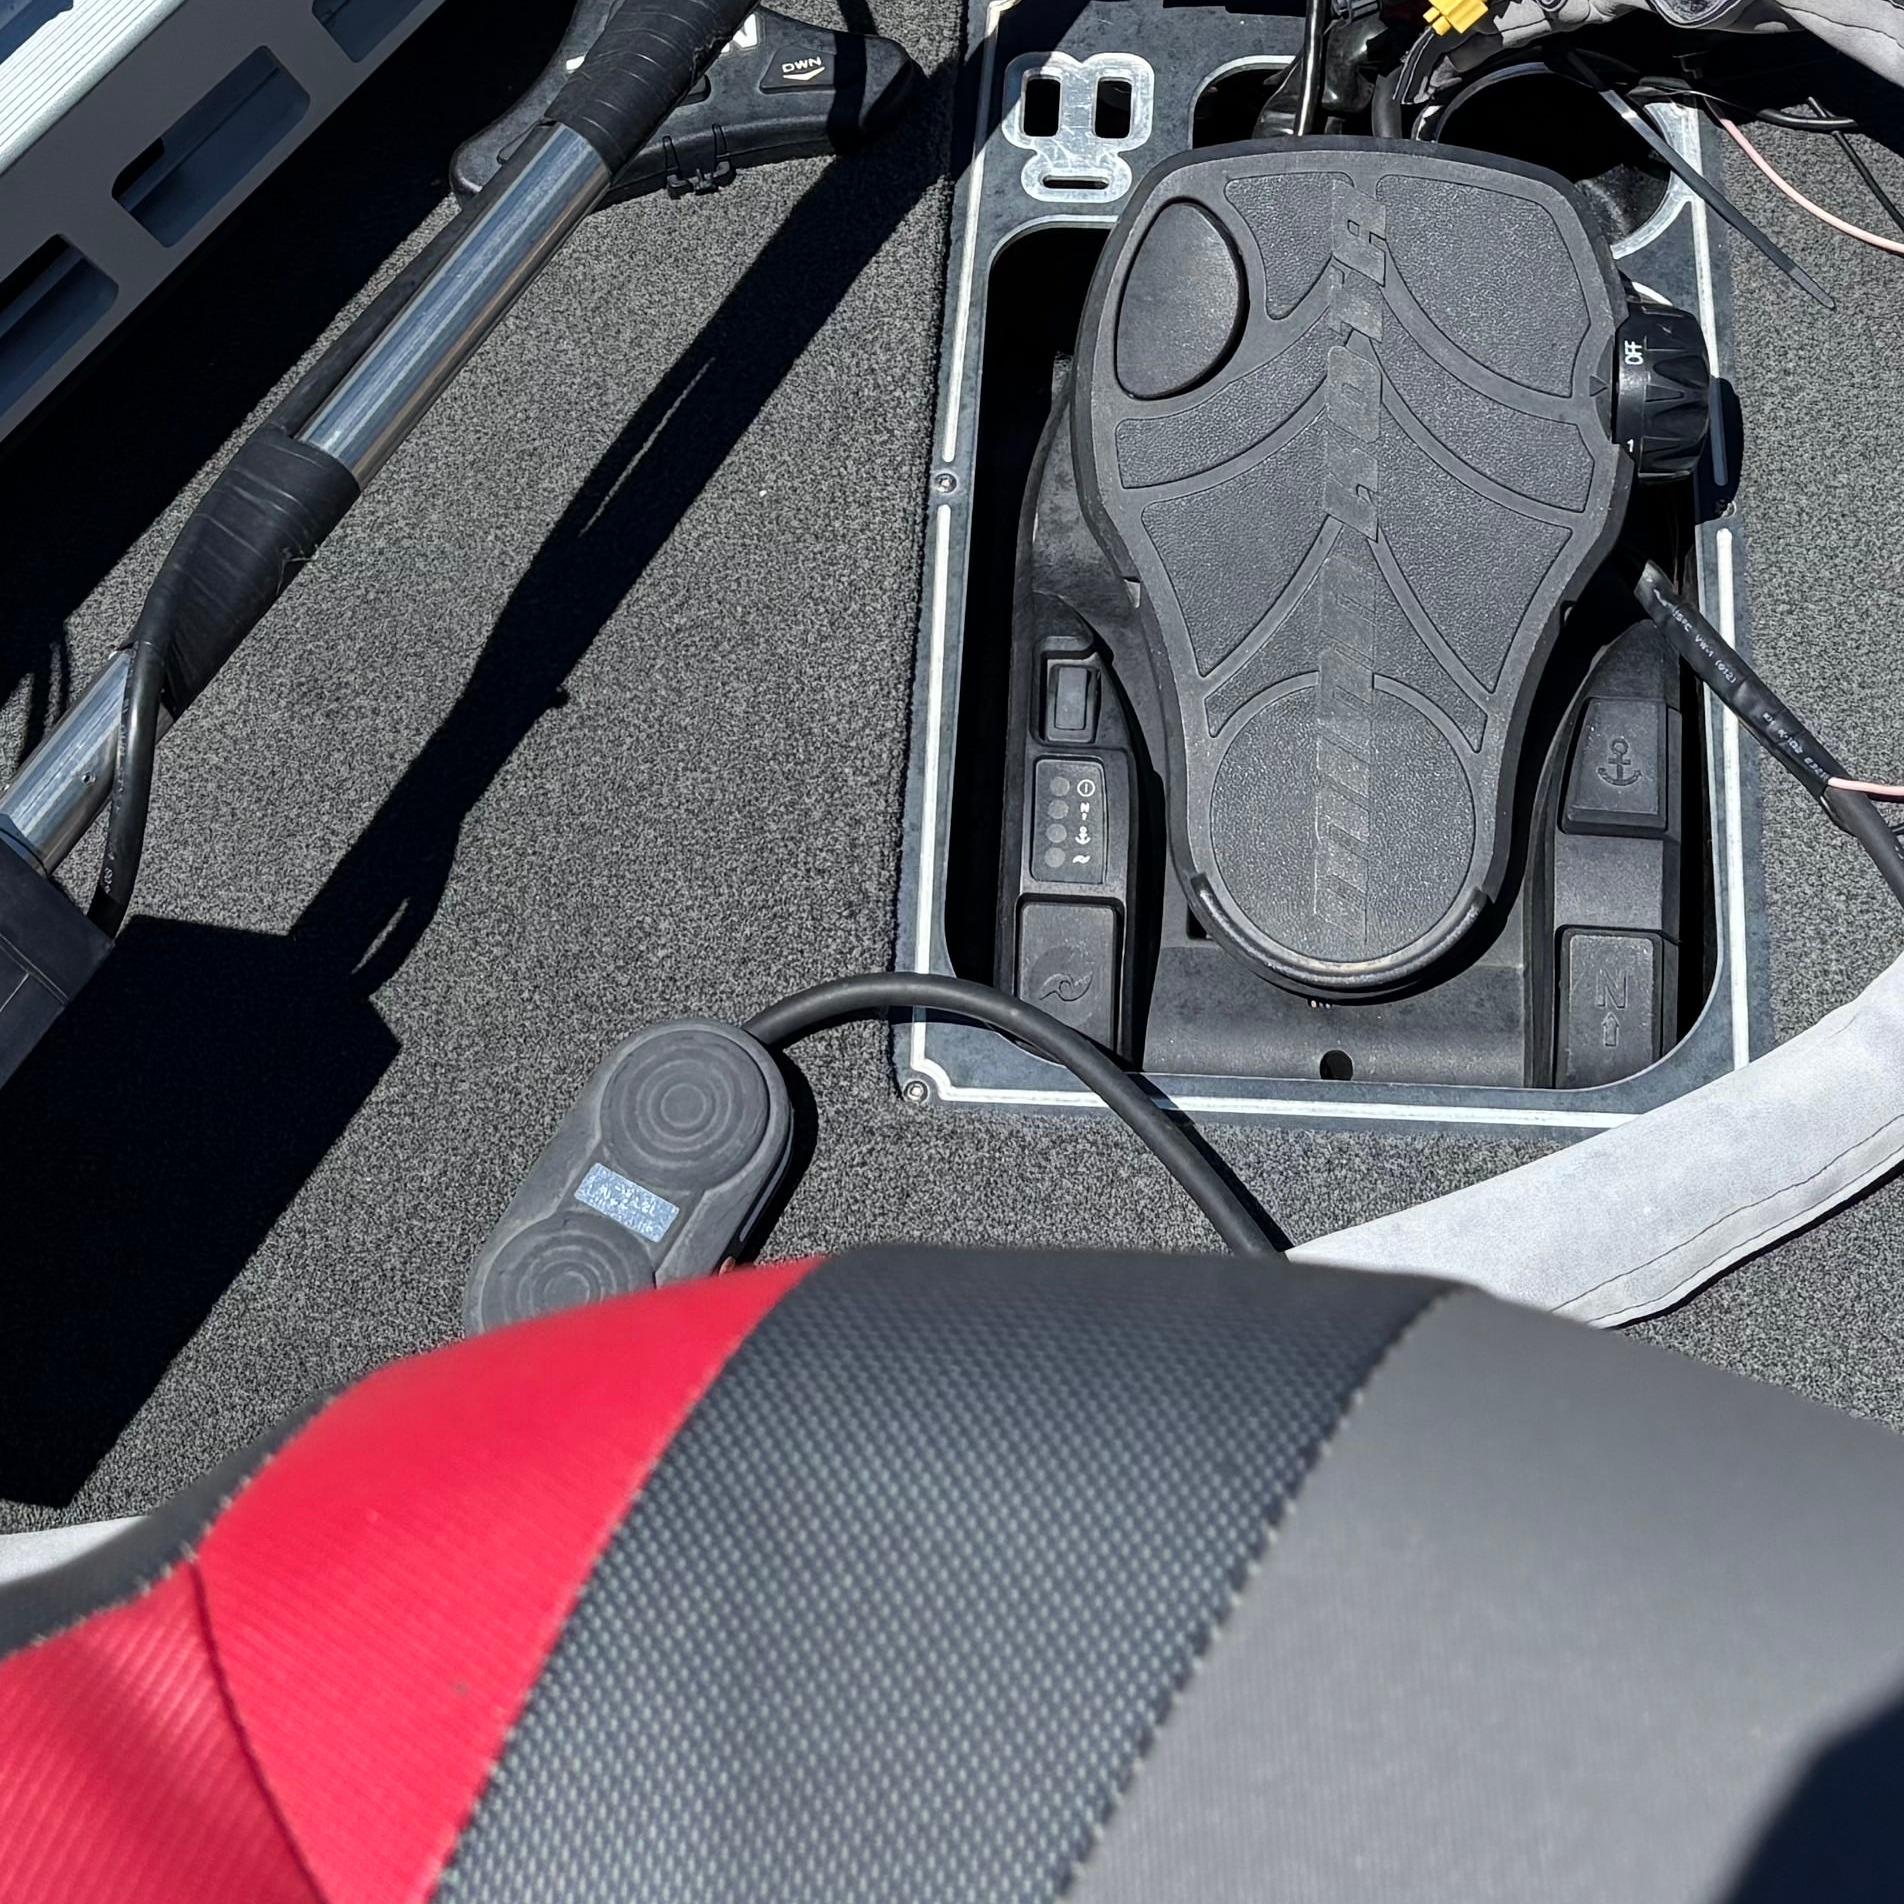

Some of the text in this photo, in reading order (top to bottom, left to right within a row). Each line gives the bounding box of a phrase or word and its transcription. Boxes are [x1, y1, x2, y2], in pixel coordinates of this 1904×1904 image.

[782, 56, 822, 74] DWN
[1624, 340, 1644, 366] OFF
[1627, 438, 1635, 453] 1
